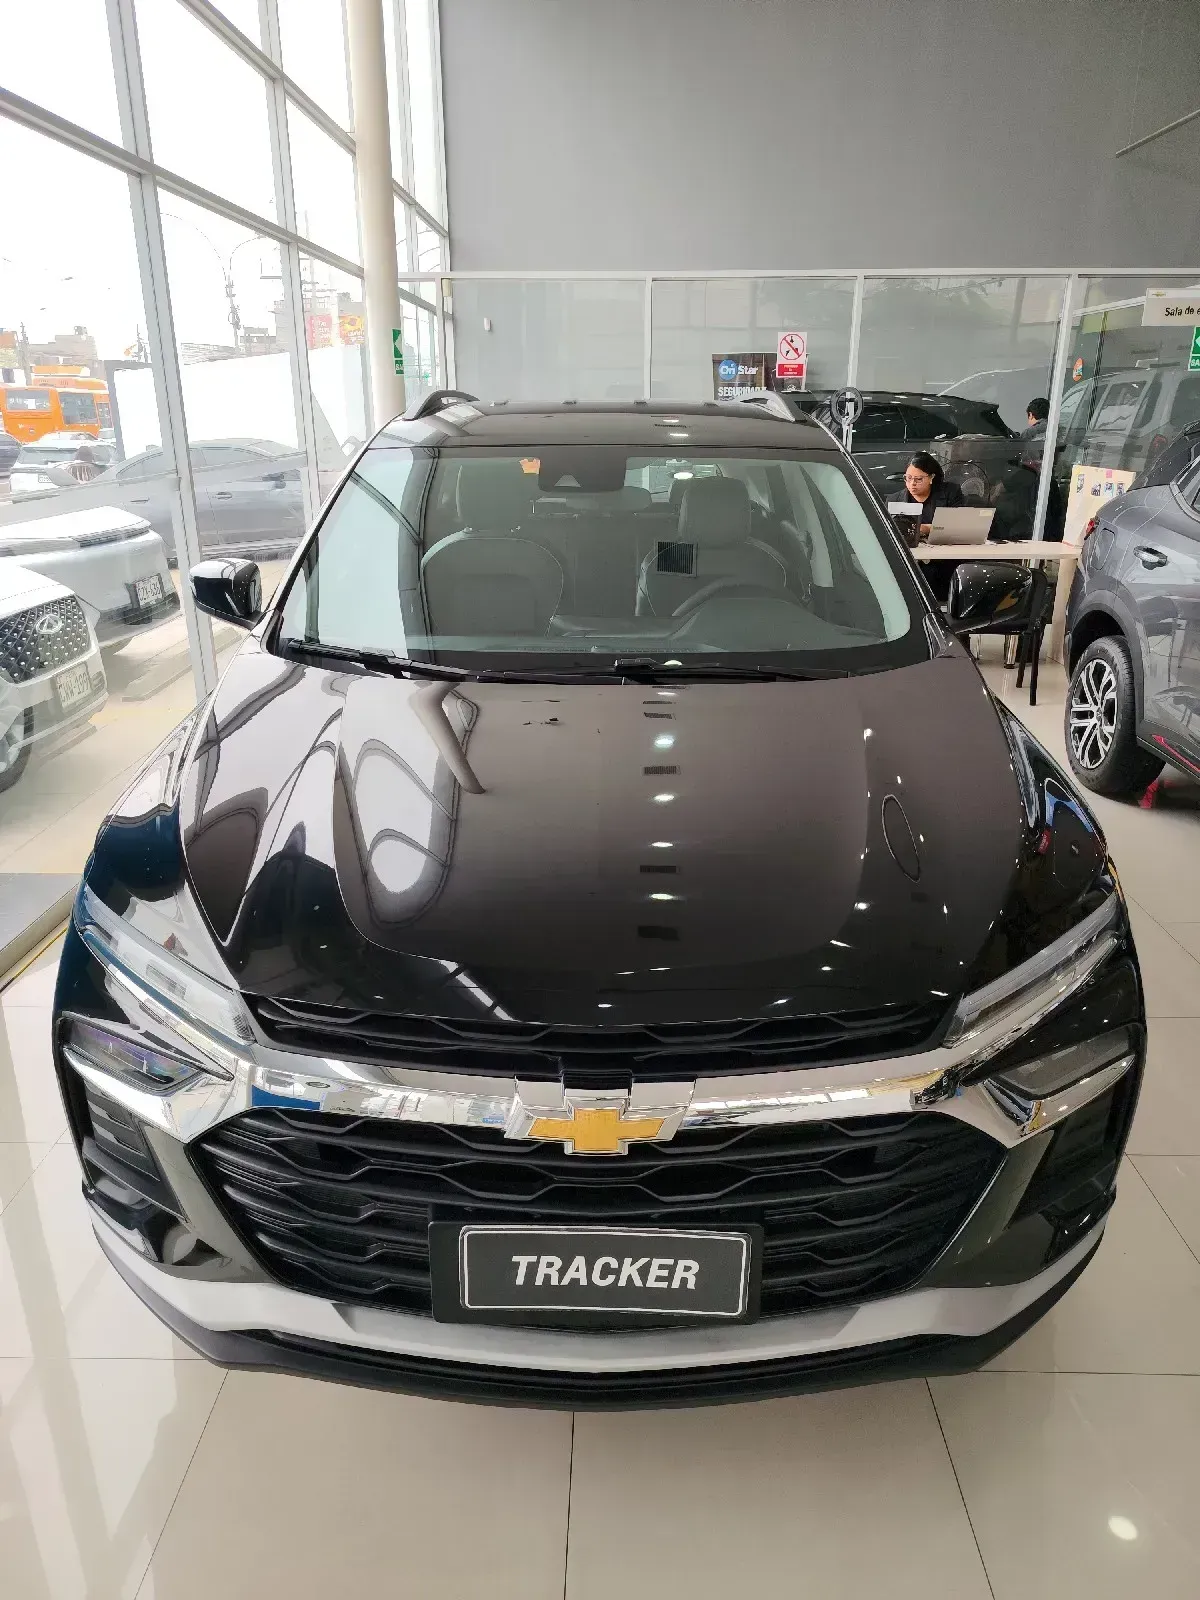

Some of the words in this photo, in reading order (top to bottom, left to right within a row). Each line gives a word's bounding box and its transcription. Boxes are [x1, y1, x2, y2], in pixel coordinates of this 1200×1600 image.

[1164, 306, 1183, 317] Sala
[1184, 305, 1195, 315] de
[511, 1255, 700, 1290] TRACKER
